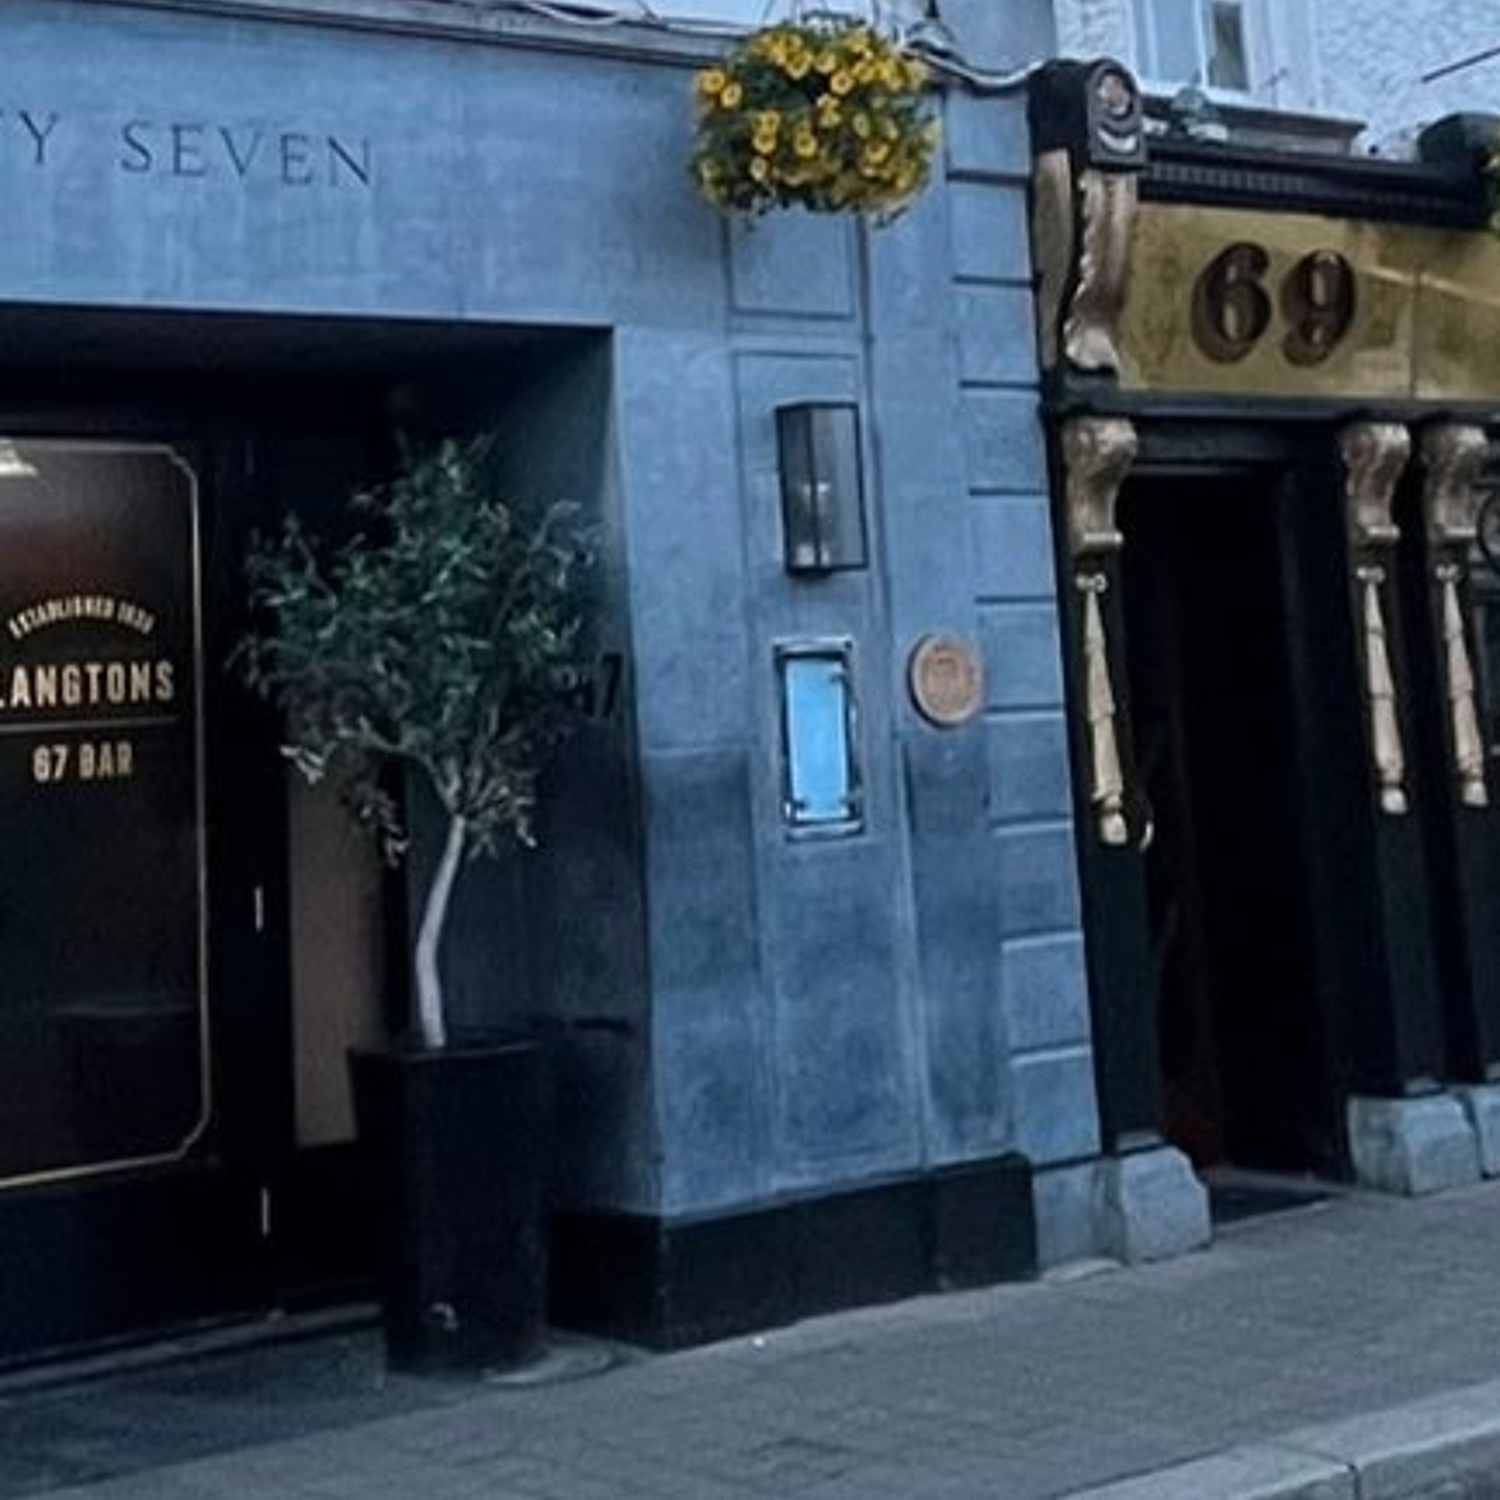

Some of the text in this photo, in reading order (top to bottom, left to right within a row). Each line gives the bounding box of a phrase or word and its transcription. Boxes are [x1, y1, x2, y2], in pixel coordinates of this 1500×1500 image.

[0, 109, 371, 188] Y SEVEN
[1191, 241, 1355, 369] 69
[0, 659, 175, 708] ANGTONS
[33, 740, 133, 782] 67 BAR
